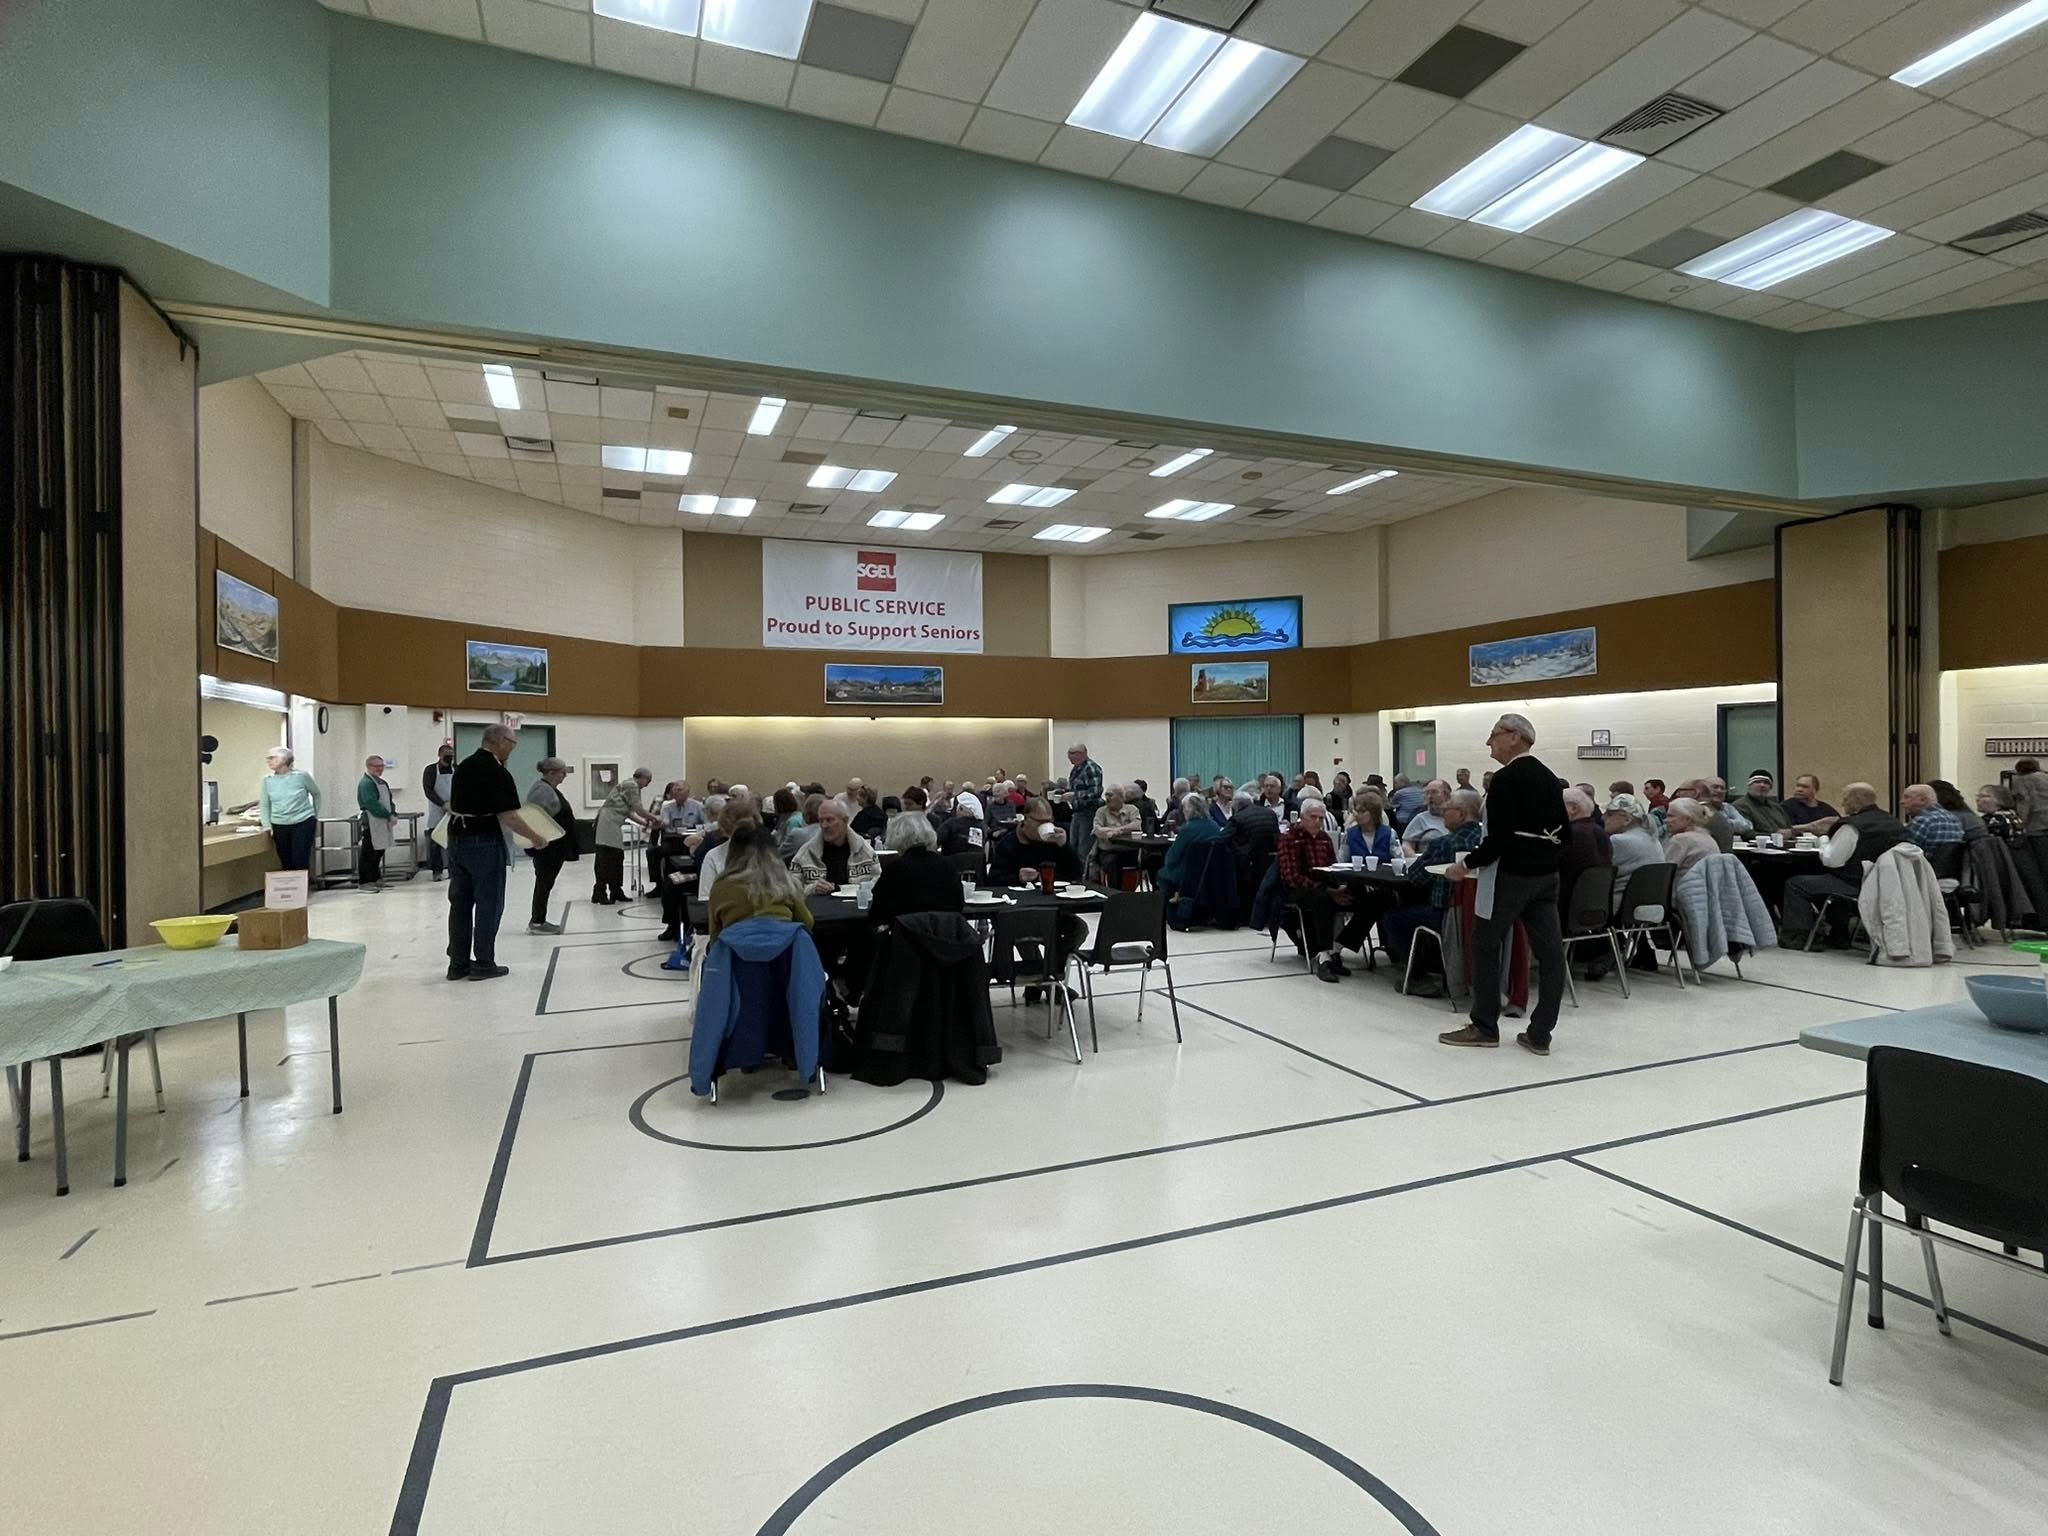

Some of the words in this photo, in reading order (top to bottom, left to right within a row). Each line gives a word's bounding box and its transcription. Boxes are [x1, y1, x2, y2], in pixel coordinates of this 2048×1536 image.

[857, 563, 896, 579] SGEU
[806, 596, 870, 612] PUBLIC
[875, 600, 945, 616] SERVICE
[767, 618, 820, 634] Proud
[825, 622, 842, 635] to
[847, 622, 916, 640] Support
[921, 625, 980, 640] Seniors
